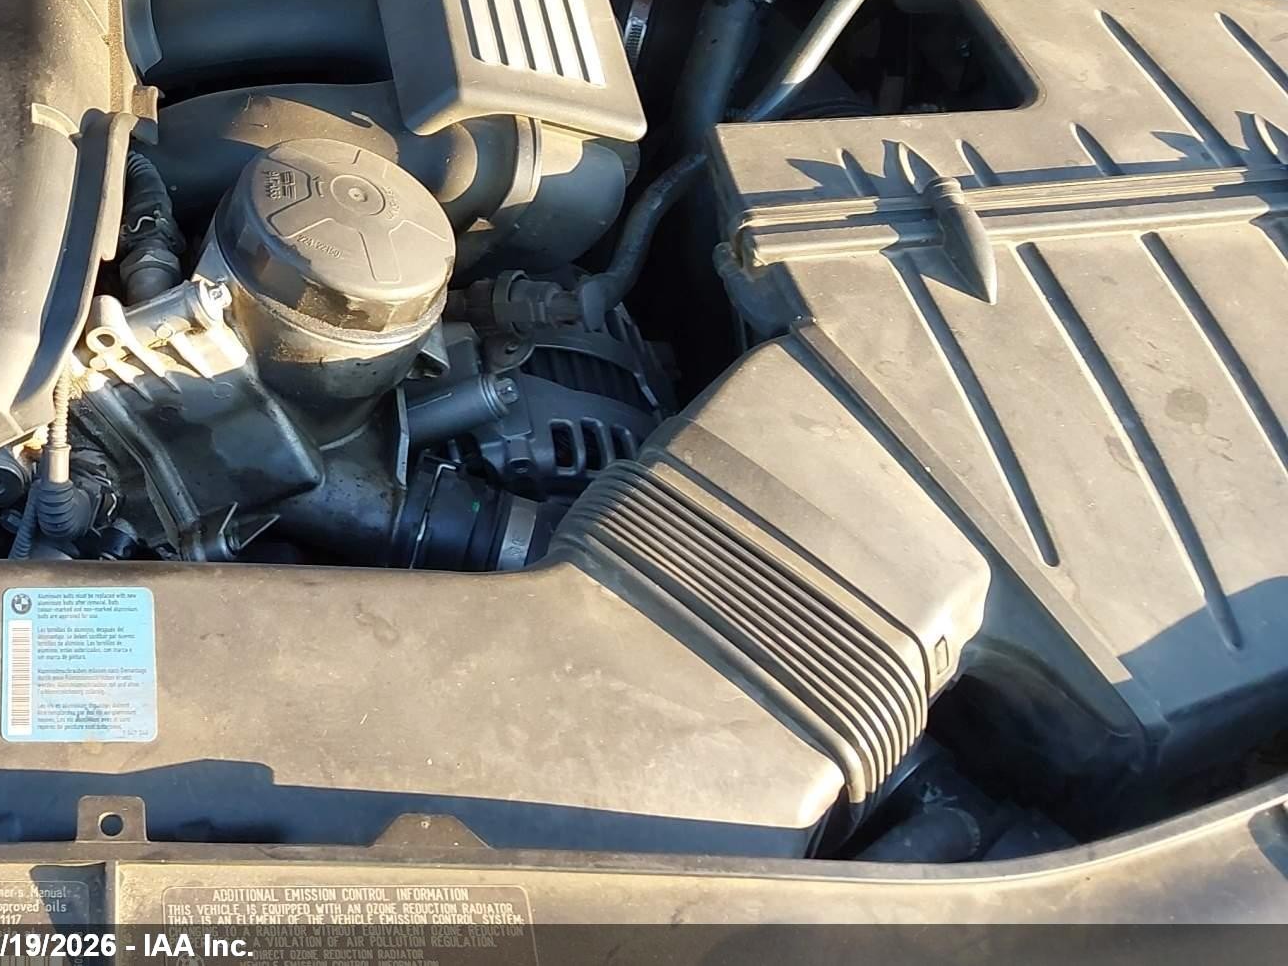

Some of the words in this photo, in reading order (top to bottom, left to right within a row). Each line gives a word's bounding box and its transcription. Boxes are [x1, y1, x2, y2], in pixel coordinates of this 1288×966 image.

[31, 886, 66, 897] Manual
[213, 889, 280, 902] ADDITIONAL
[284, 889, 336, 902] EMISSION
[342, 889, 390, 902] CONTROL
[397, 889, 469, 902] INFORMATION
[45, 899, 67, 912] oils
[168, 904, 191, 915] THIS
[196, 904, 240, 915] VEHICLE
[246, 904, 257, 915] IS
[262, 904, 310, 915] EQUIPPED
[315, 903, 341, 914] WITH
[347, 903, 361, 914] AN
[366, 903, 396, 914] OZONE
[402, 903, 457, 914] REDUCTION
[462, 903, 513, 914] RADIATOR
[168, 915, 194, 926] THAT
[201, 915, 211, 926] IS
[217, 915, 231, 926] AN
[236, 915, 284, 926] ELEMENT
[288, 914, 299, 925] OF
[307, 914, 324, 925] THE
[331, 914, 373, 925] VEHICLE
[379, 914, 426, 925] EMISSION
[432, 914, 477, 925] CONTROL
